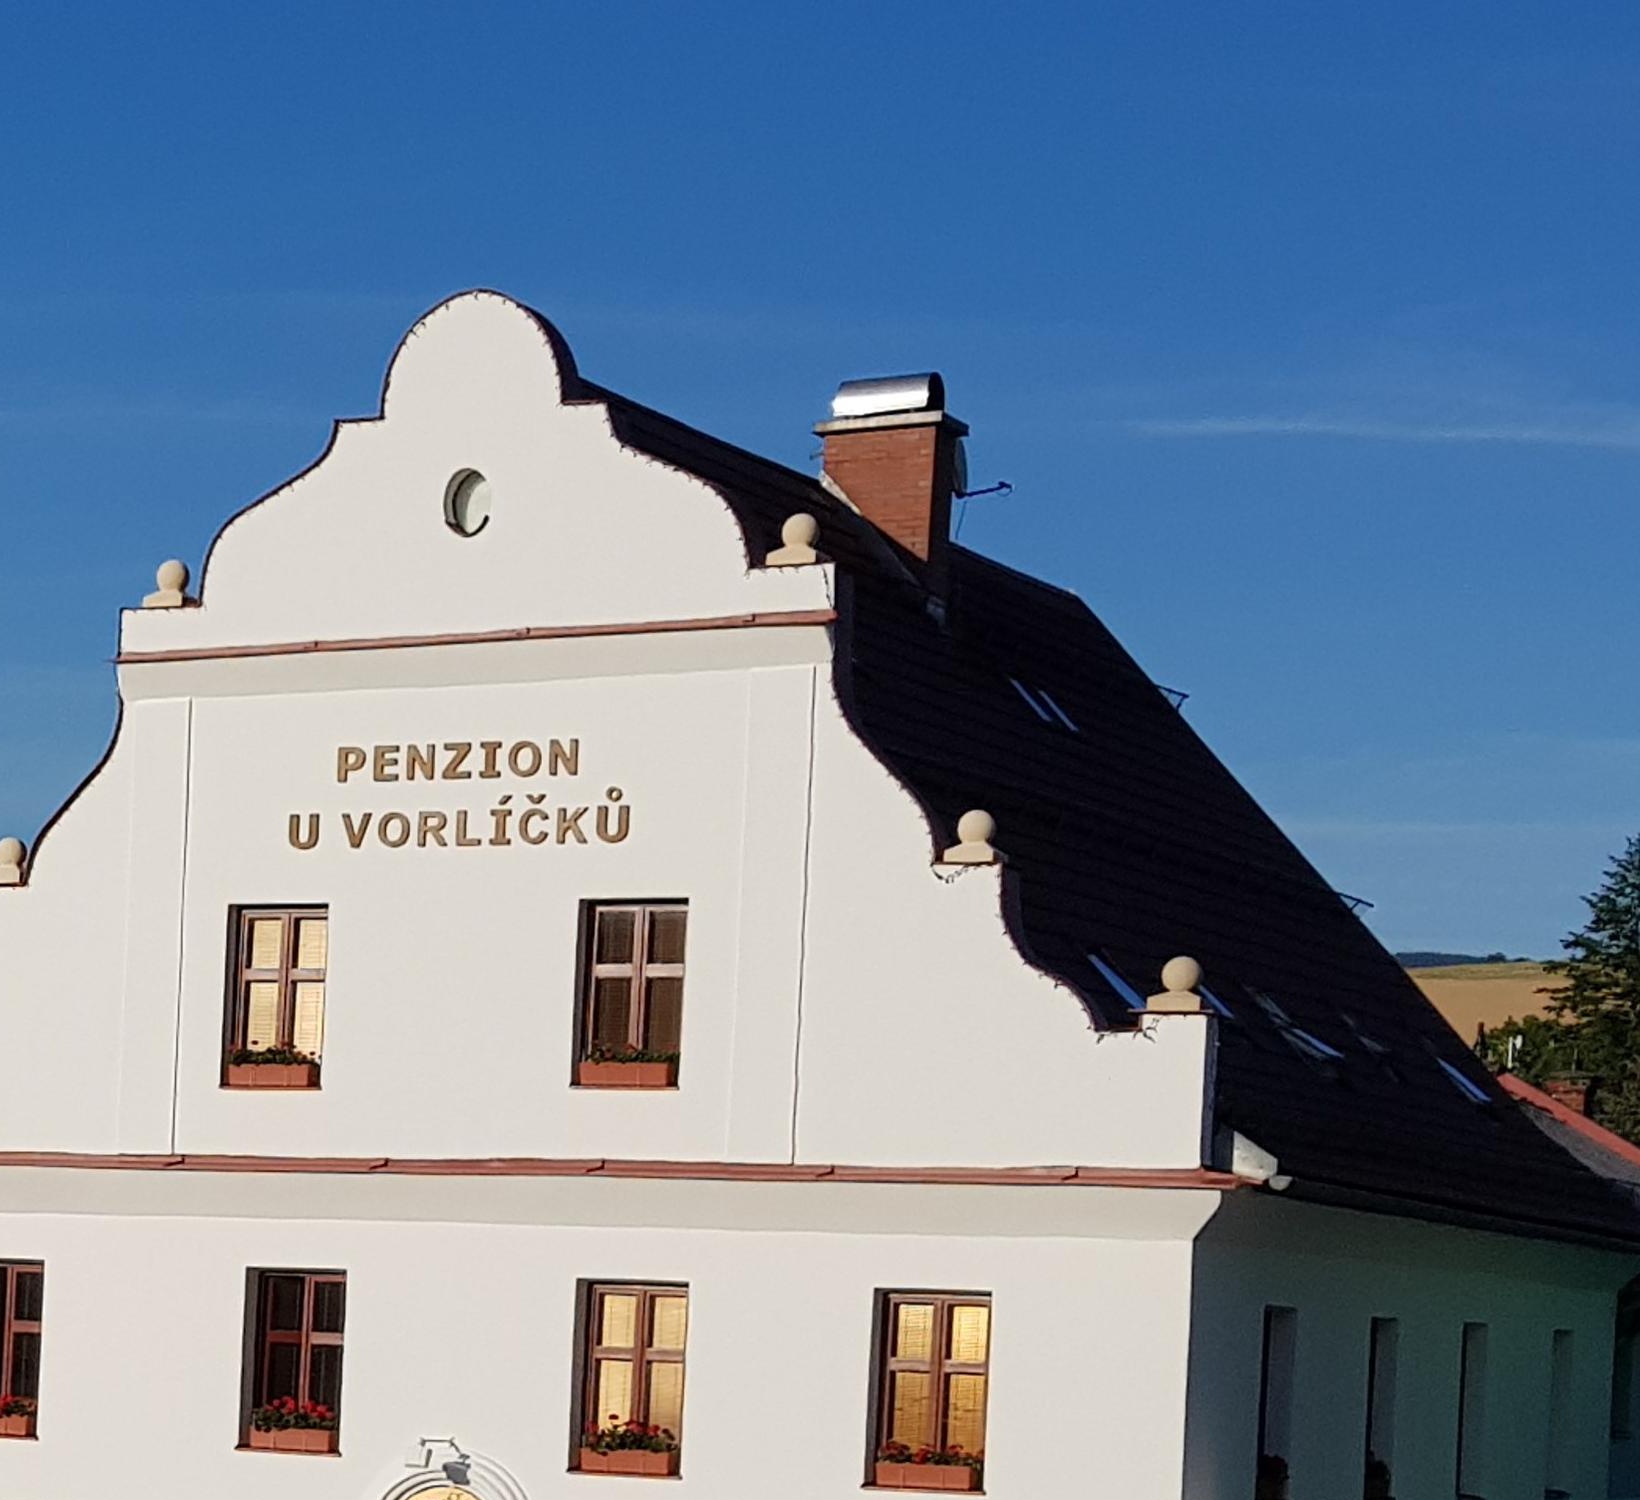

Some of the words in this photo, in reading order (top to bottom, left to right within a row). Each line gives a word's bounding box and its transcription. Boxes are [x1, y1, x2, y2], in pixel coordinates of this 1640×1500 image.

[336, 738, 580, 783] PENZION
[288, 812, 321, 850] U
[341, 786, 631, 849] VORLÍČKŮ
